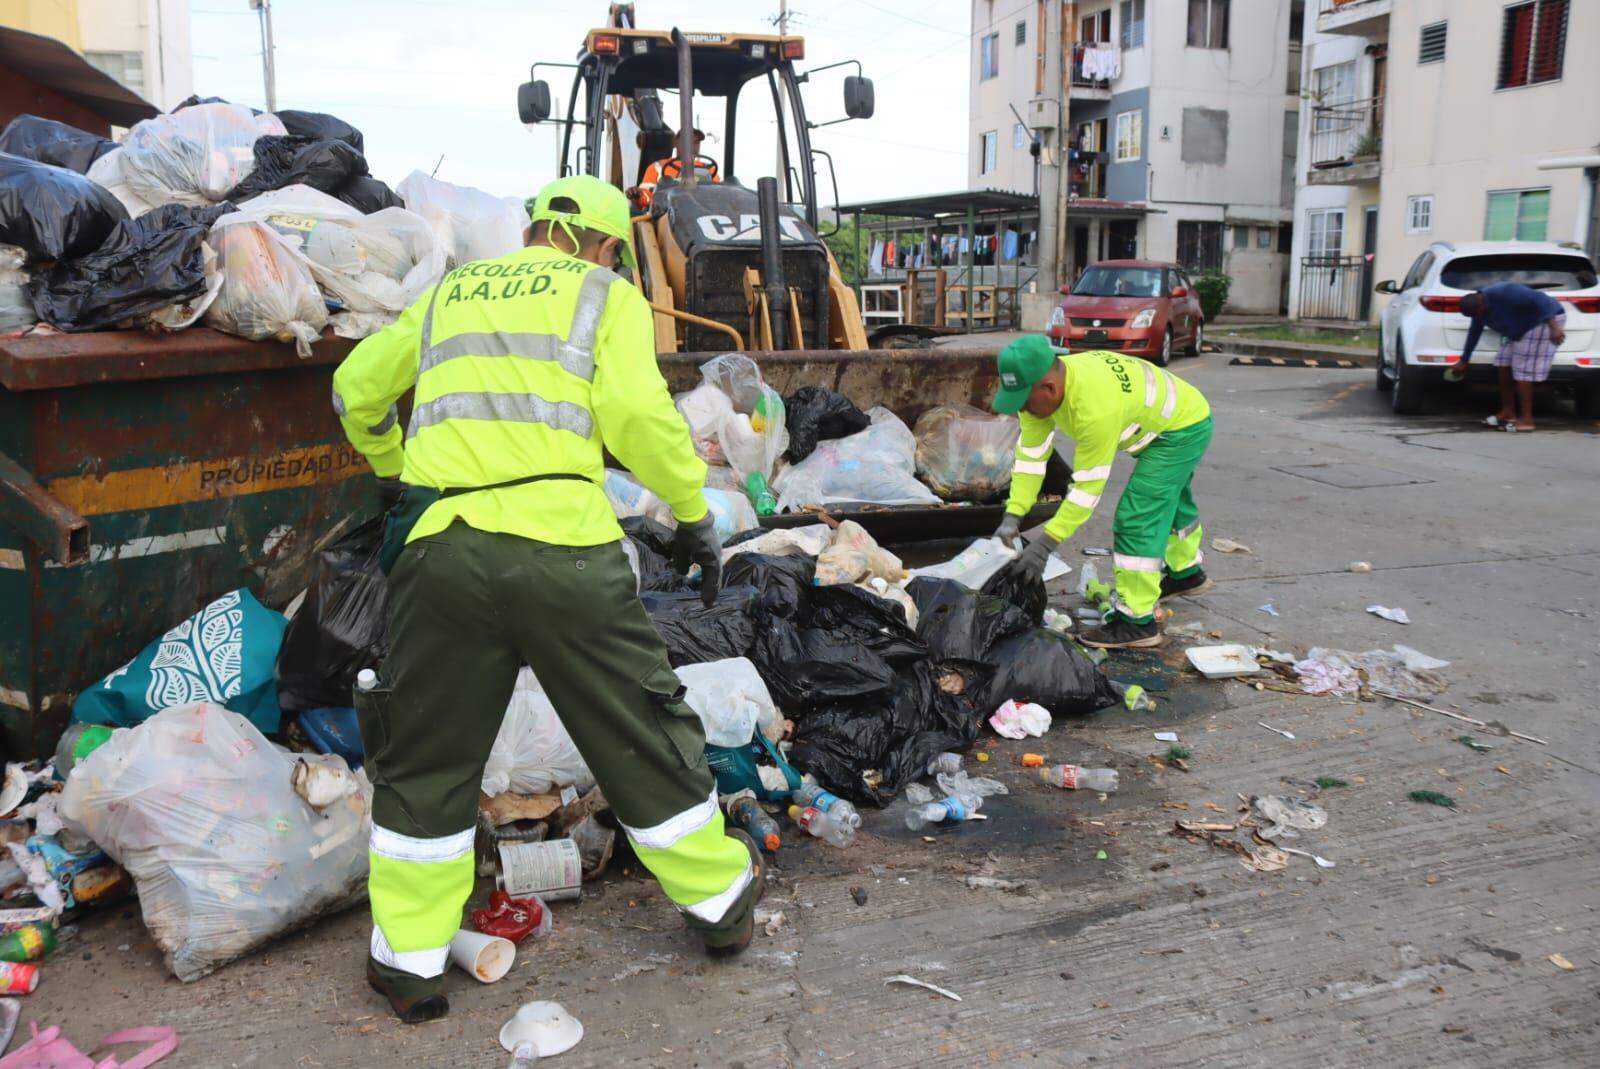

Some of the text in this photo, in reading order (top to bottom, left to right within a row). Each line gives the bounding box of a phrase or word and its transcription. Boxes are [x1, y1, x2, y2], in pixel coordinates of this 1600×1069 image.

[447, 260, 588, 283] RECOLECTOR
[445, 275, 557, 306] A.A.U.D.
[200, 454, 333, 489] PROPIEDAD
